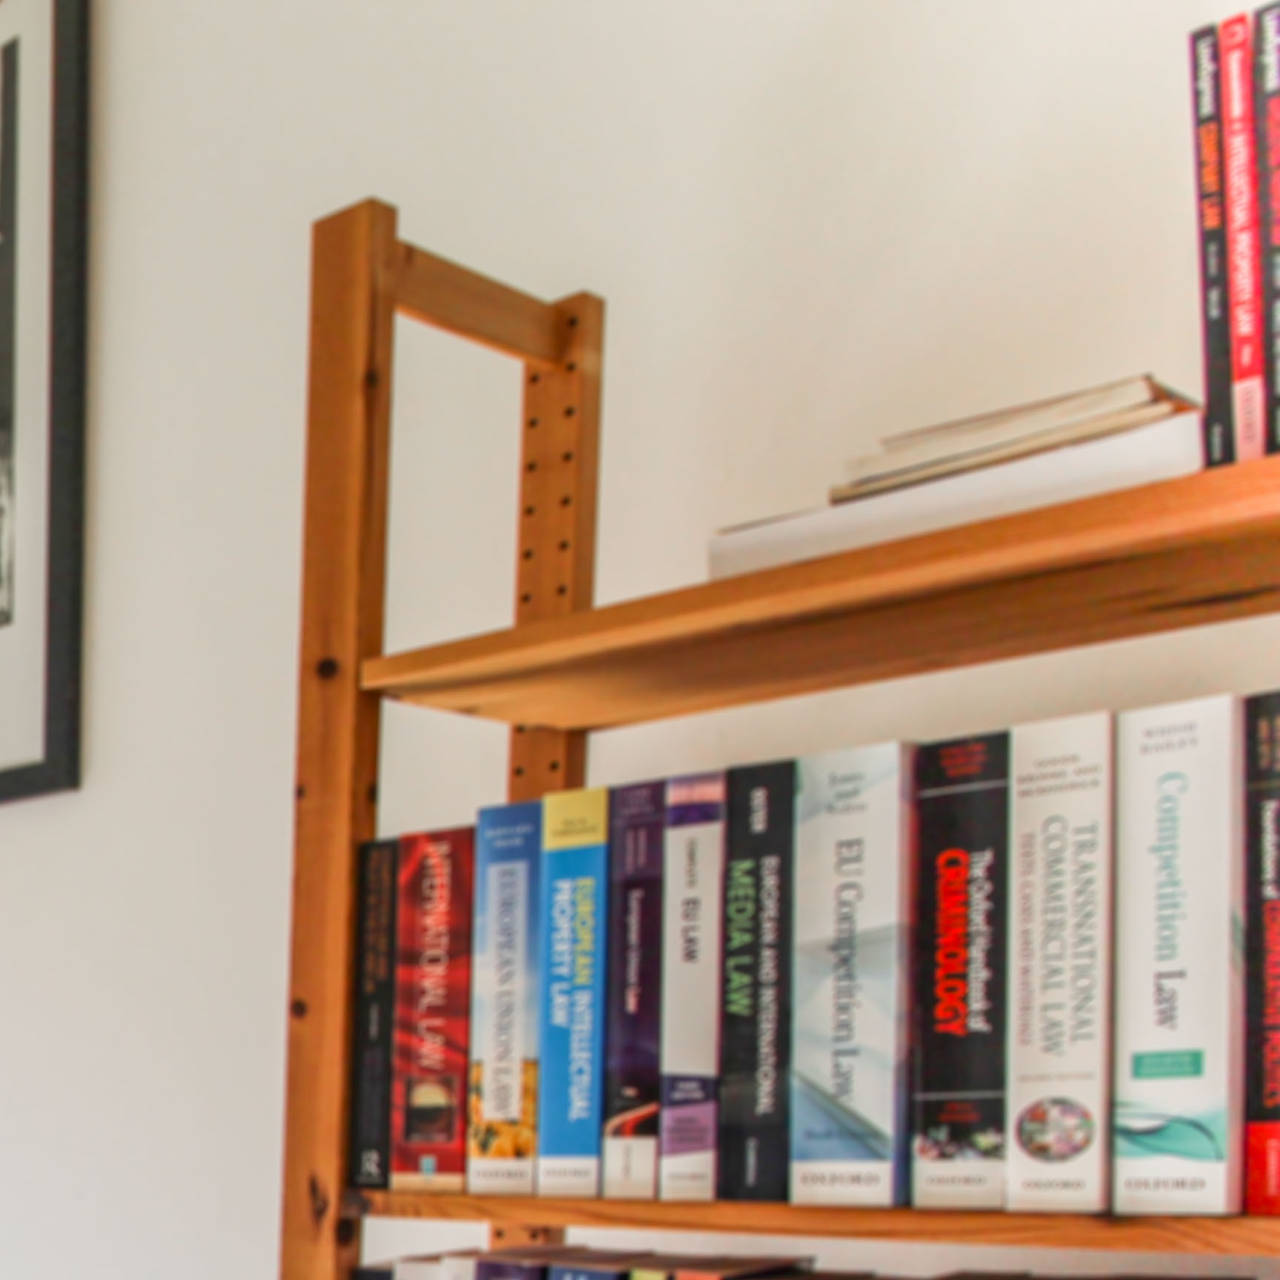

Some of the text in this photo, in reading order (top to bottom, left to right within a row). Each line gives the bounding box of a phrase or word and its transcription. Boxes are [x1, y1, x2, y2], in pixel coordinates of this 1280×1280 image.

[1234, 305, 1254, 335] LAW
[494, 866, 518, 984] EUROPEAN
[682, 896, 700, 922] EU
[967, 879, 993, 930] Oxford
[968, 847, 993, 878] The
[1038, 815, 1068, 1056] COMMERCIAL LAW
[1070, 821, 1099, 1044] TRANSNATIONAL
[1149, 772, 1190, 962] Competition
[417, 841, 452, 1070] INTERNATIONAL LAW
[549, 878, 573, 1027] PROPERTY LAW
[567, 877, 596, 1122] EUROPEAN INTELLECTUAL
[681, 926, 699, 964] LAW
[725, 858, 755, 1017] MEDIA LAW
[754, 855, 780, 1115] EUROPEAN AND INTERNATIONAL
[824, 837, 866, 1100] EU Competition Law
[932, 848, 969, 1037] CRIMINOLOGY
[1152, 970, 1187, 1031] Law
[492, 1065, 515, 1115] LAW
[493, 989, 516, 1062] UNION
